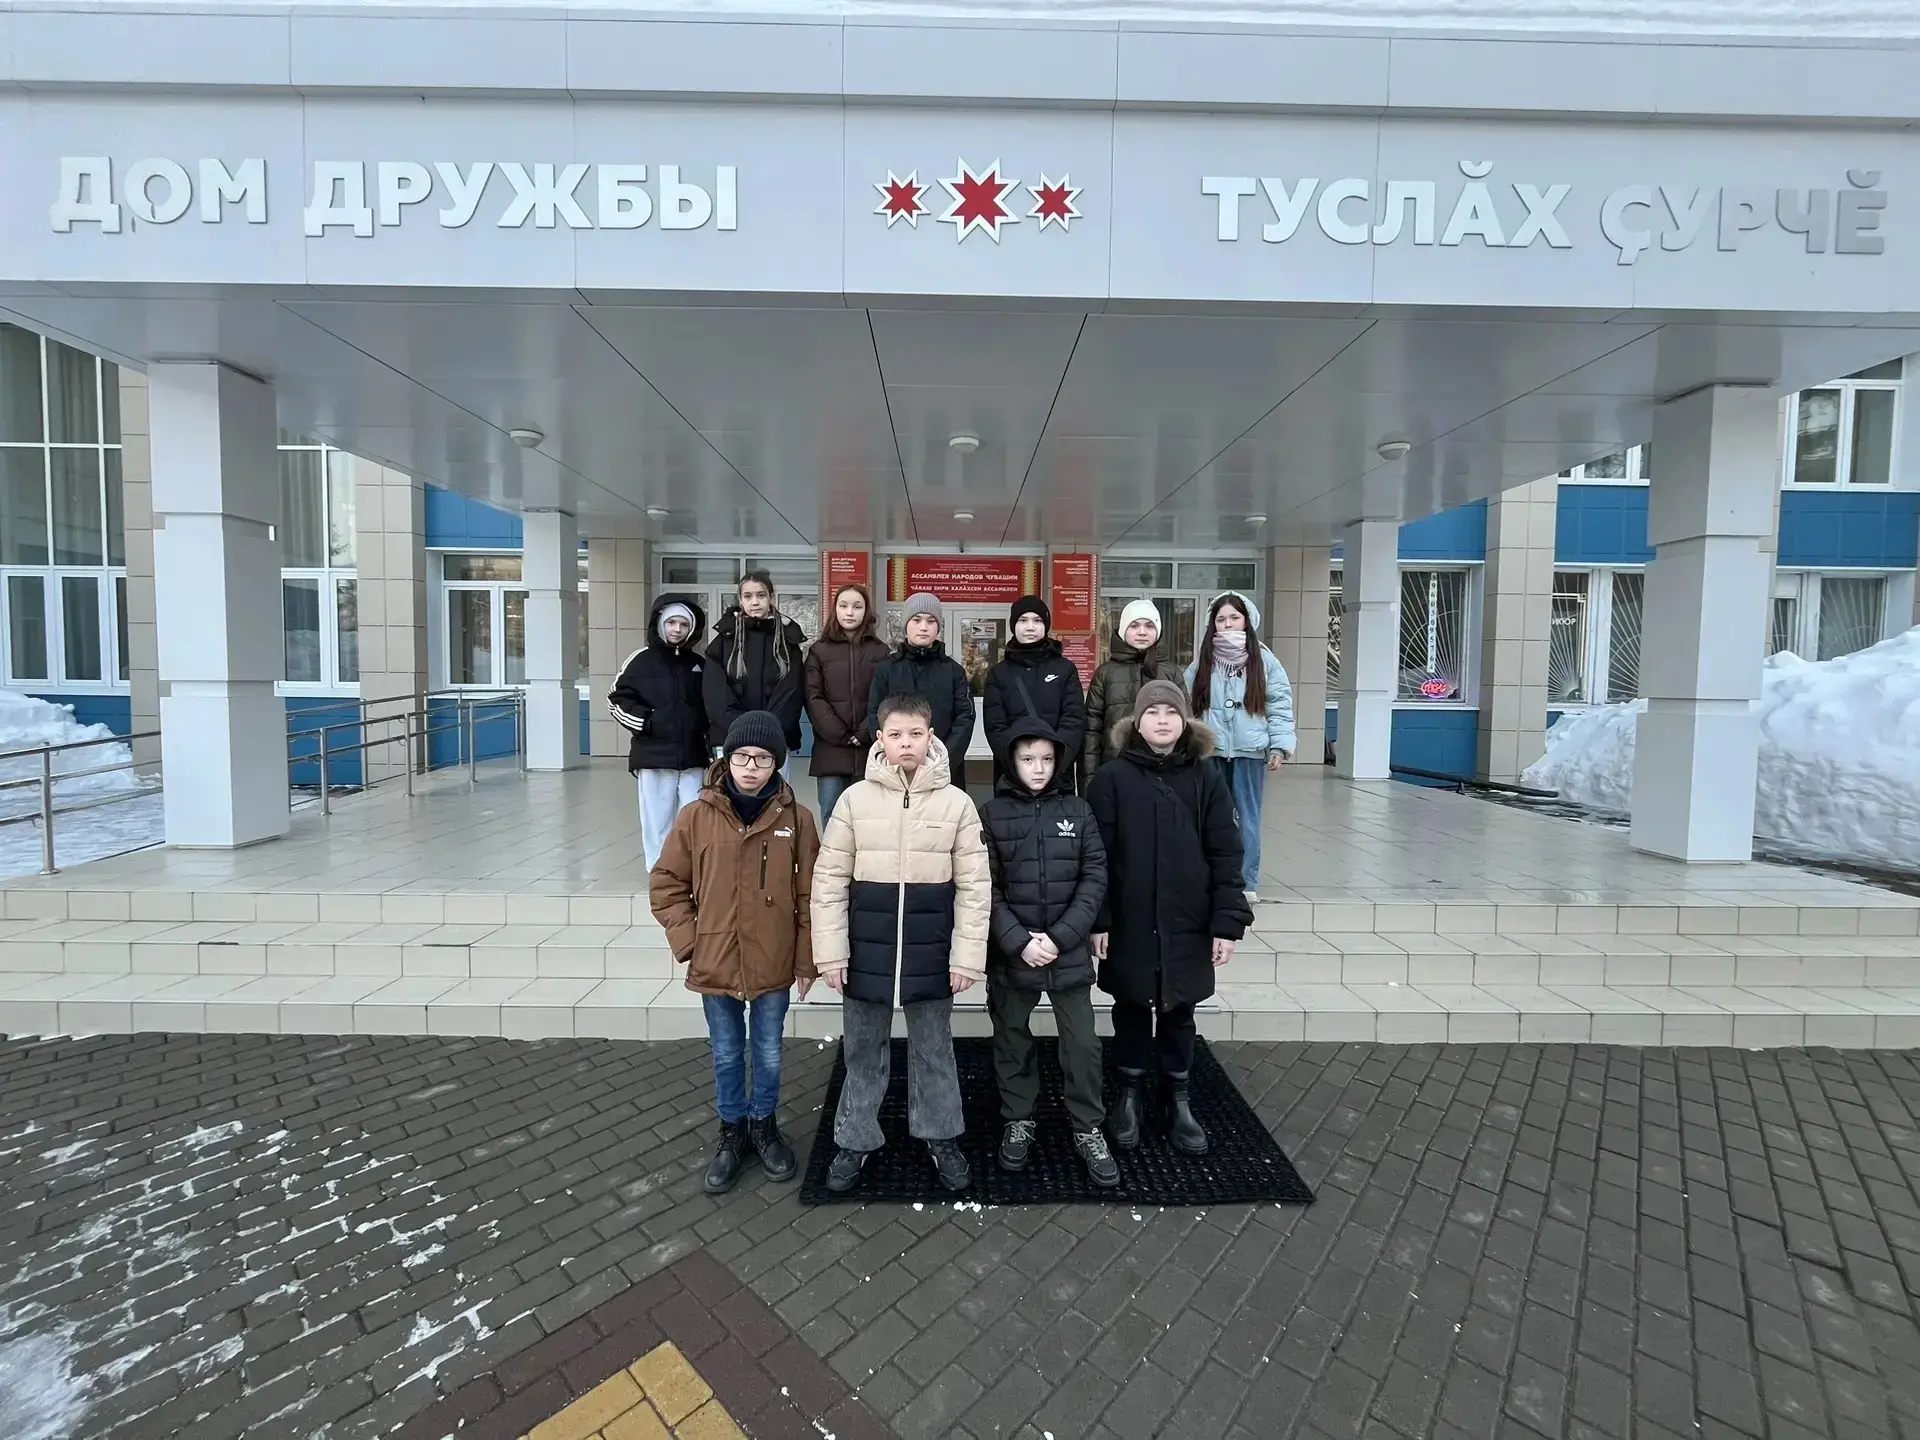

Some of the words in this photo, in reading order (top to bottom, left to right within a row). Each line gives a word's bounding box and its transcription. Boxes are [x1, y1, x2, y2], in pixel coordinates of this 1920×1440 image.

[52, 156, 269, 233] ДОМ
[304, 160, 738, 237] ДРУЖБЫ
[1201, 160, 1573, 249] ТУСЛӐХ
[1600, 168, 1886, 265] ҪУРЧӖ
[1551, 617, 1576, 626] ИКЮР
